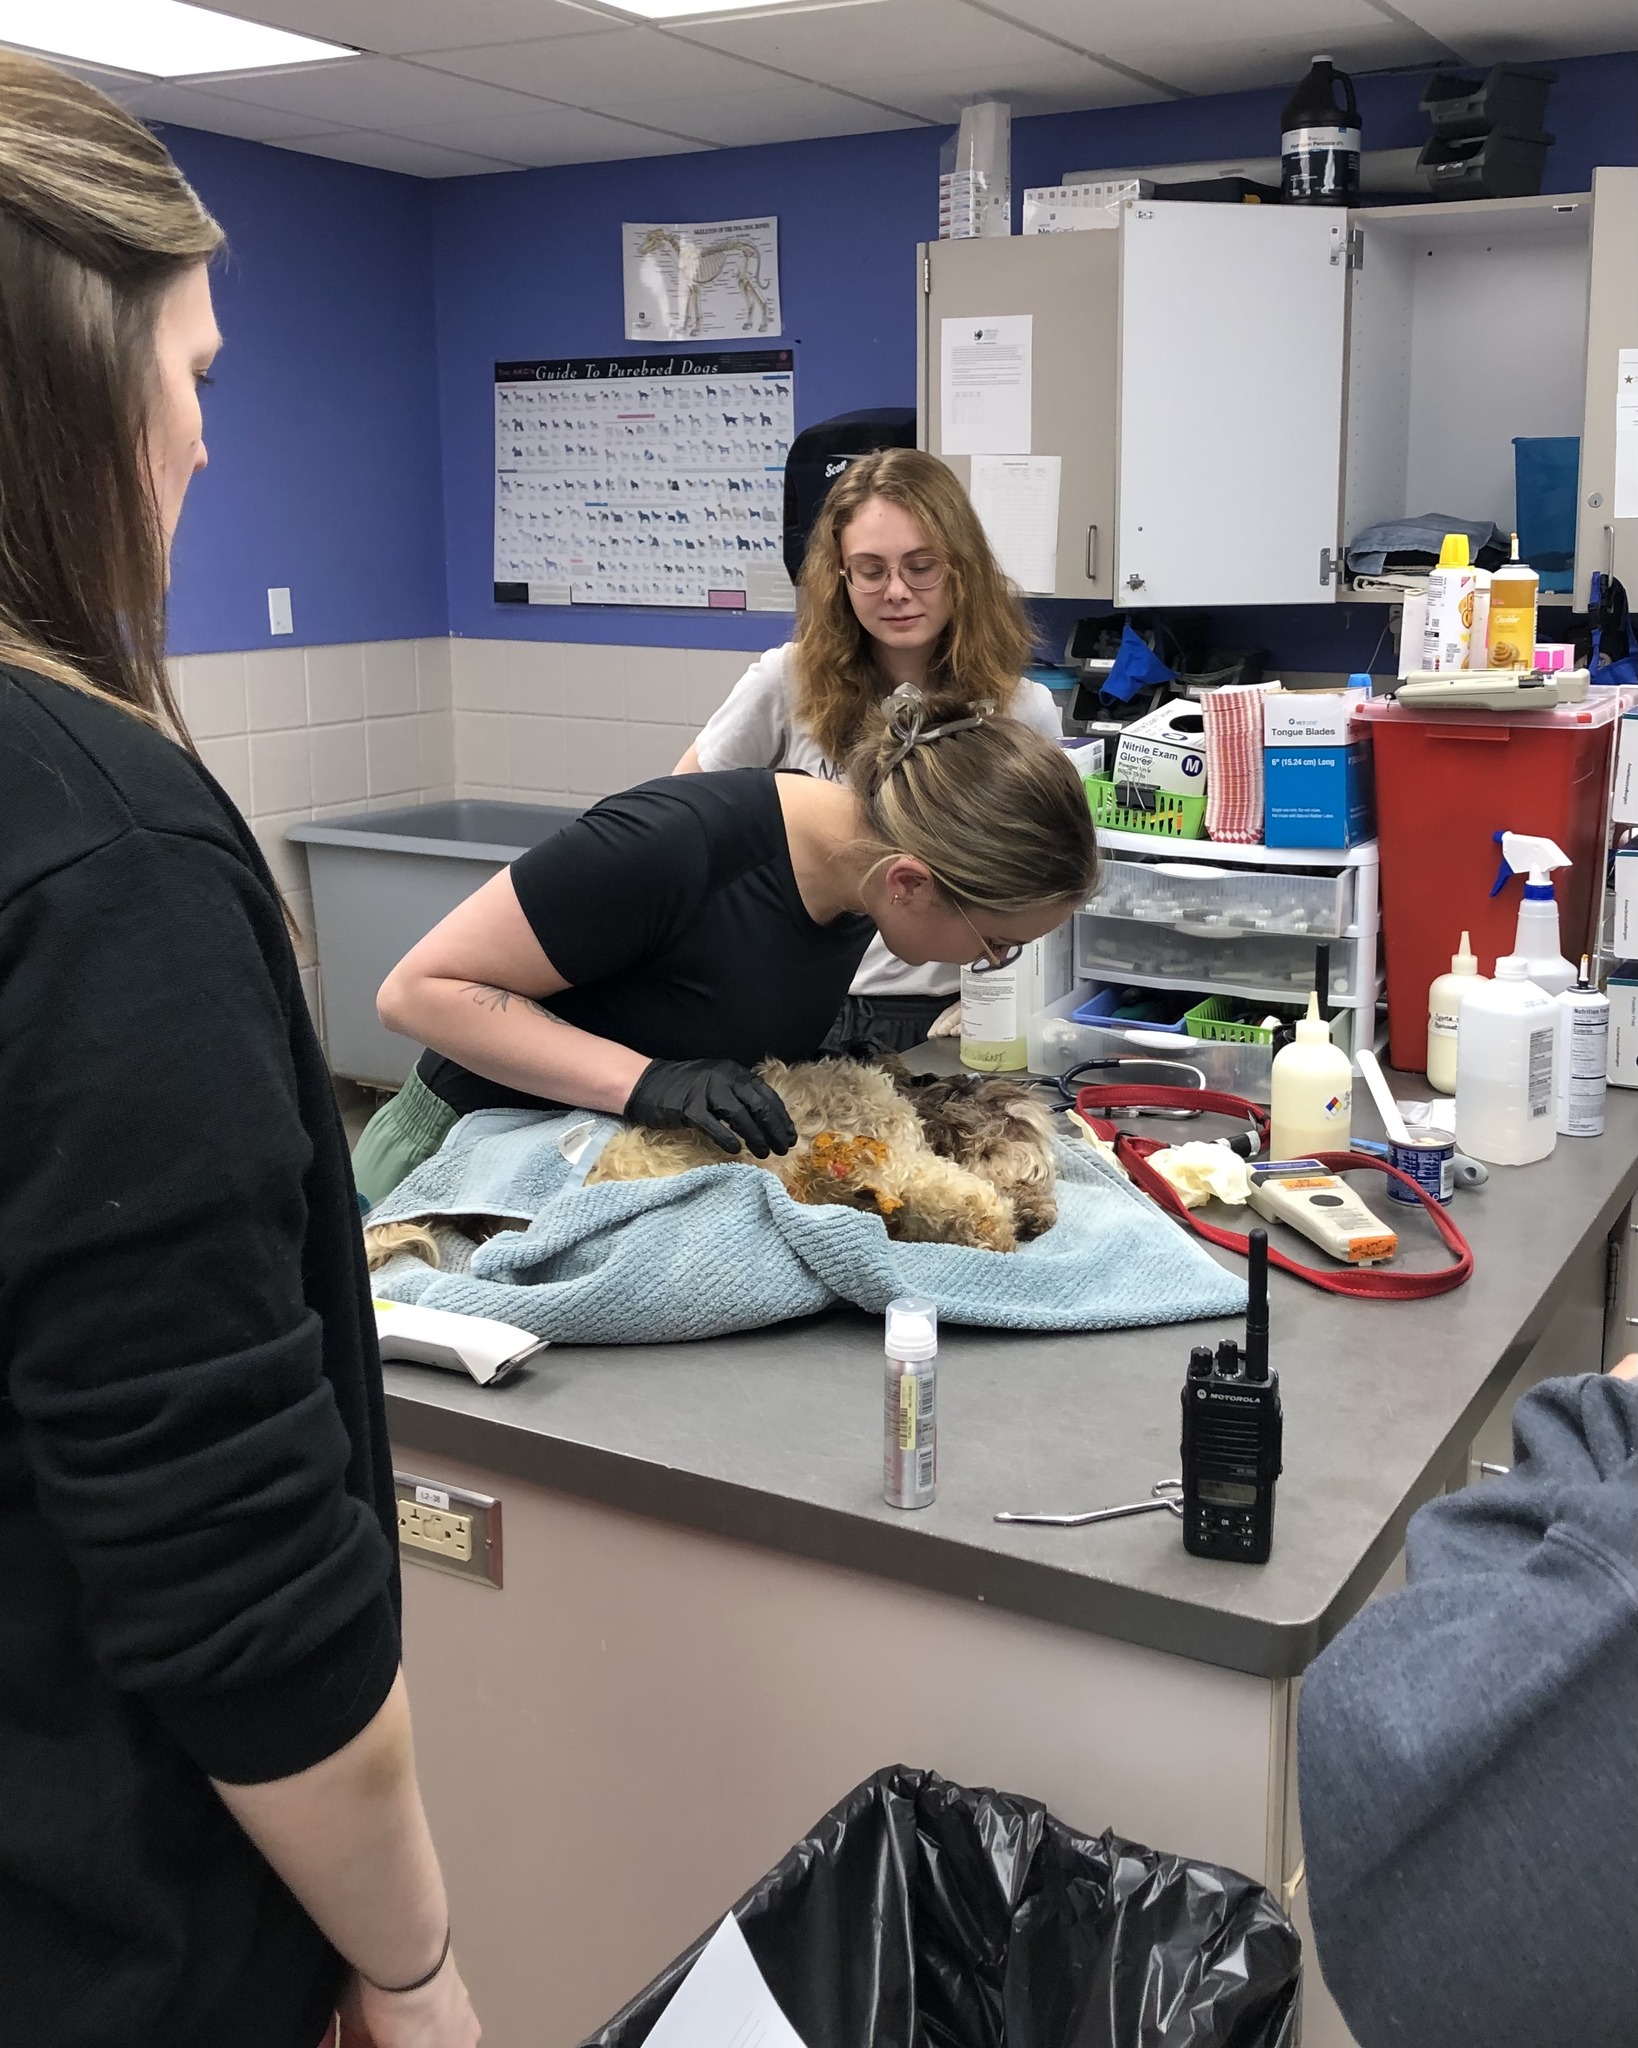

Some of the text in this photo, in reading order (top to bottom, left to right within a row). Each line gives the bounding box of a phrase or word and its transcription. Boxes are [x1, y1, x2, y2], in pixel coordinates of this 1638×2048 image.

[535, 363, 578, 380] Guide
[585, 363, 601, 379] To
[607, 358, 675, 378] Purebred
[681, 359, 719, 376] Dogs
[1271, 728, 1304, 738] Tongue
[1305, 727, 1336, 736] Blades
[1122, 740, 1179, 761] Nitrile Exam
[1120, 752, 1153, 766] Gloves
[1281, 758, 1303, 768] (15.24
[1303, 758, 1316, 768] cm)
[1318, 759, 1335, 768] Long
[1185, 758, 1200, 774] M
[1209, 1392, 1261, 1404] MOTOROLA
[420, 1491, 441, 1504] L2-38
